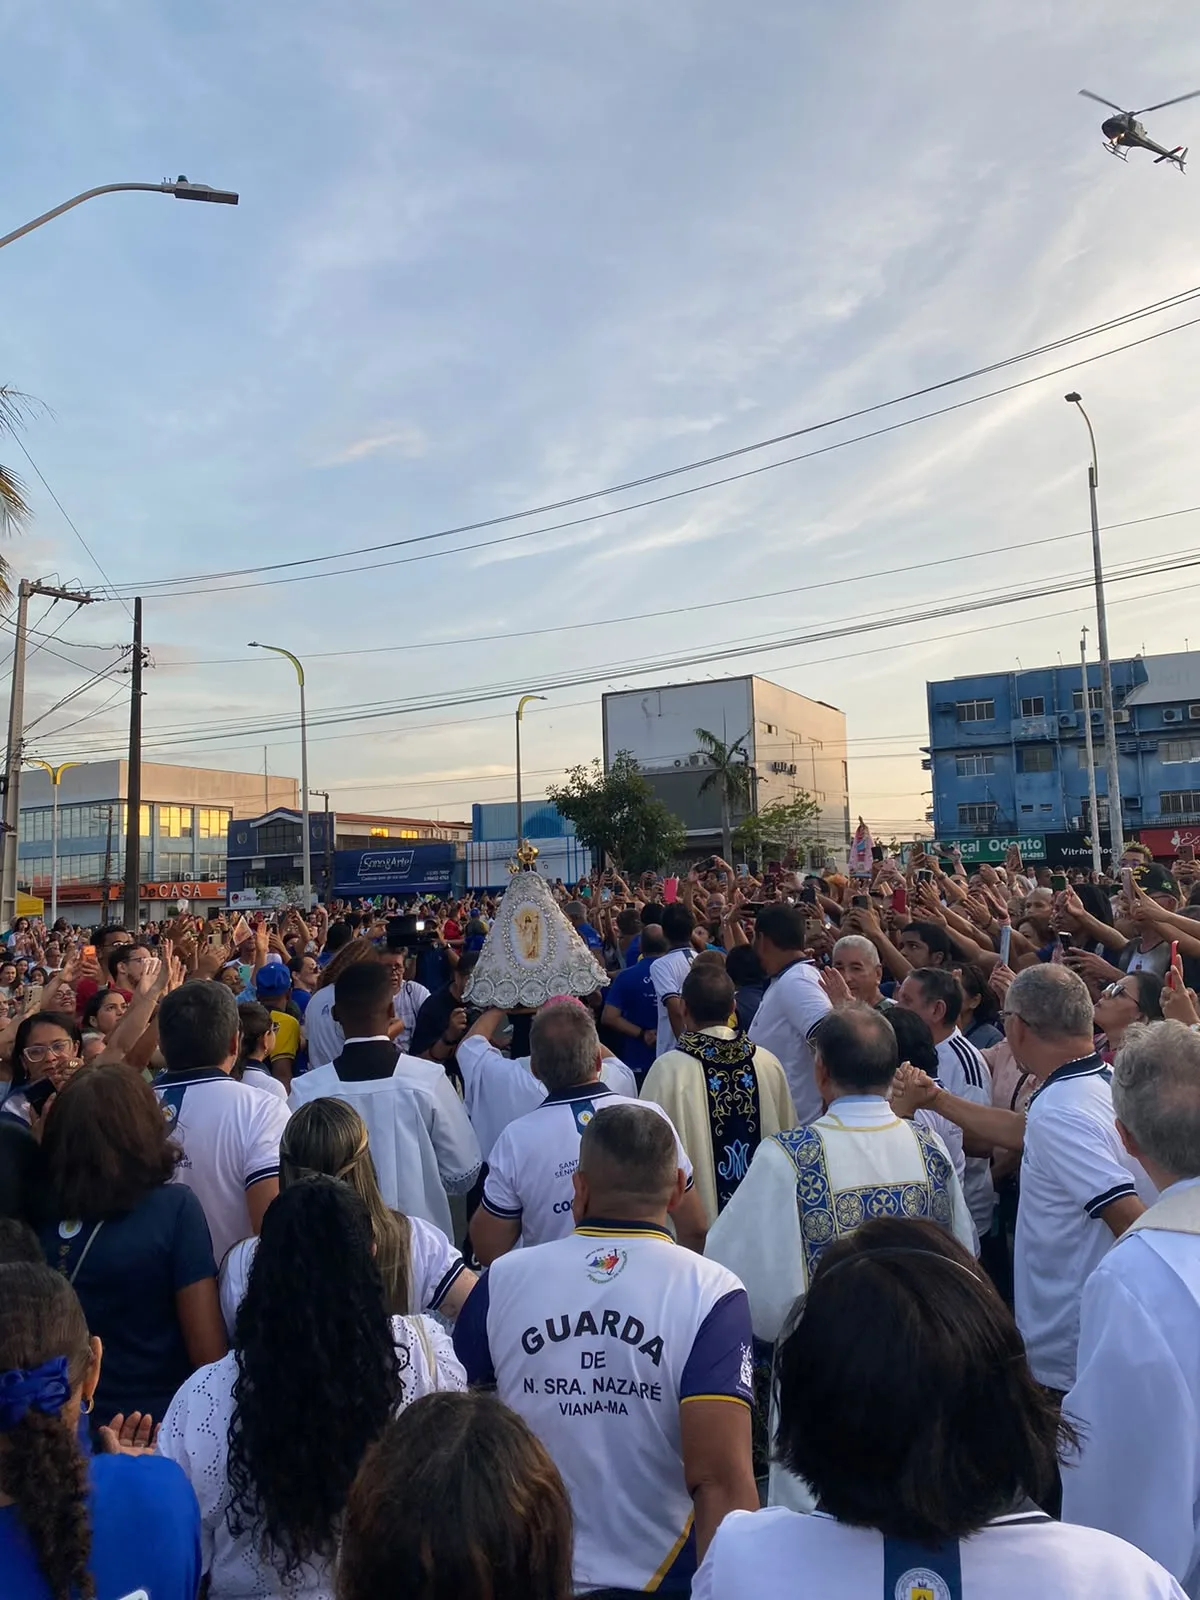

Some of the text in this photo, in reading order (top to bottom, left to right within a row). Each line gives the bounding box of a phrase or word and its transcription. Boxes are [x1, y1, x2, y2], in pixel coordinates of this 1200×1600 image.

[988, 838, 1042, 852] Odnto
[1060, 847, 1093, 856] Vitrine
[158, 884, 202, 898] CASA
[521, 1309, 665, 1367] GUARDA
[580, 1350, 606, 1370] DE
[523, 1375, 663, 1402] N. SRA. NAZARÉ
[558, 1399, 629, 1417] VIANA-MA
